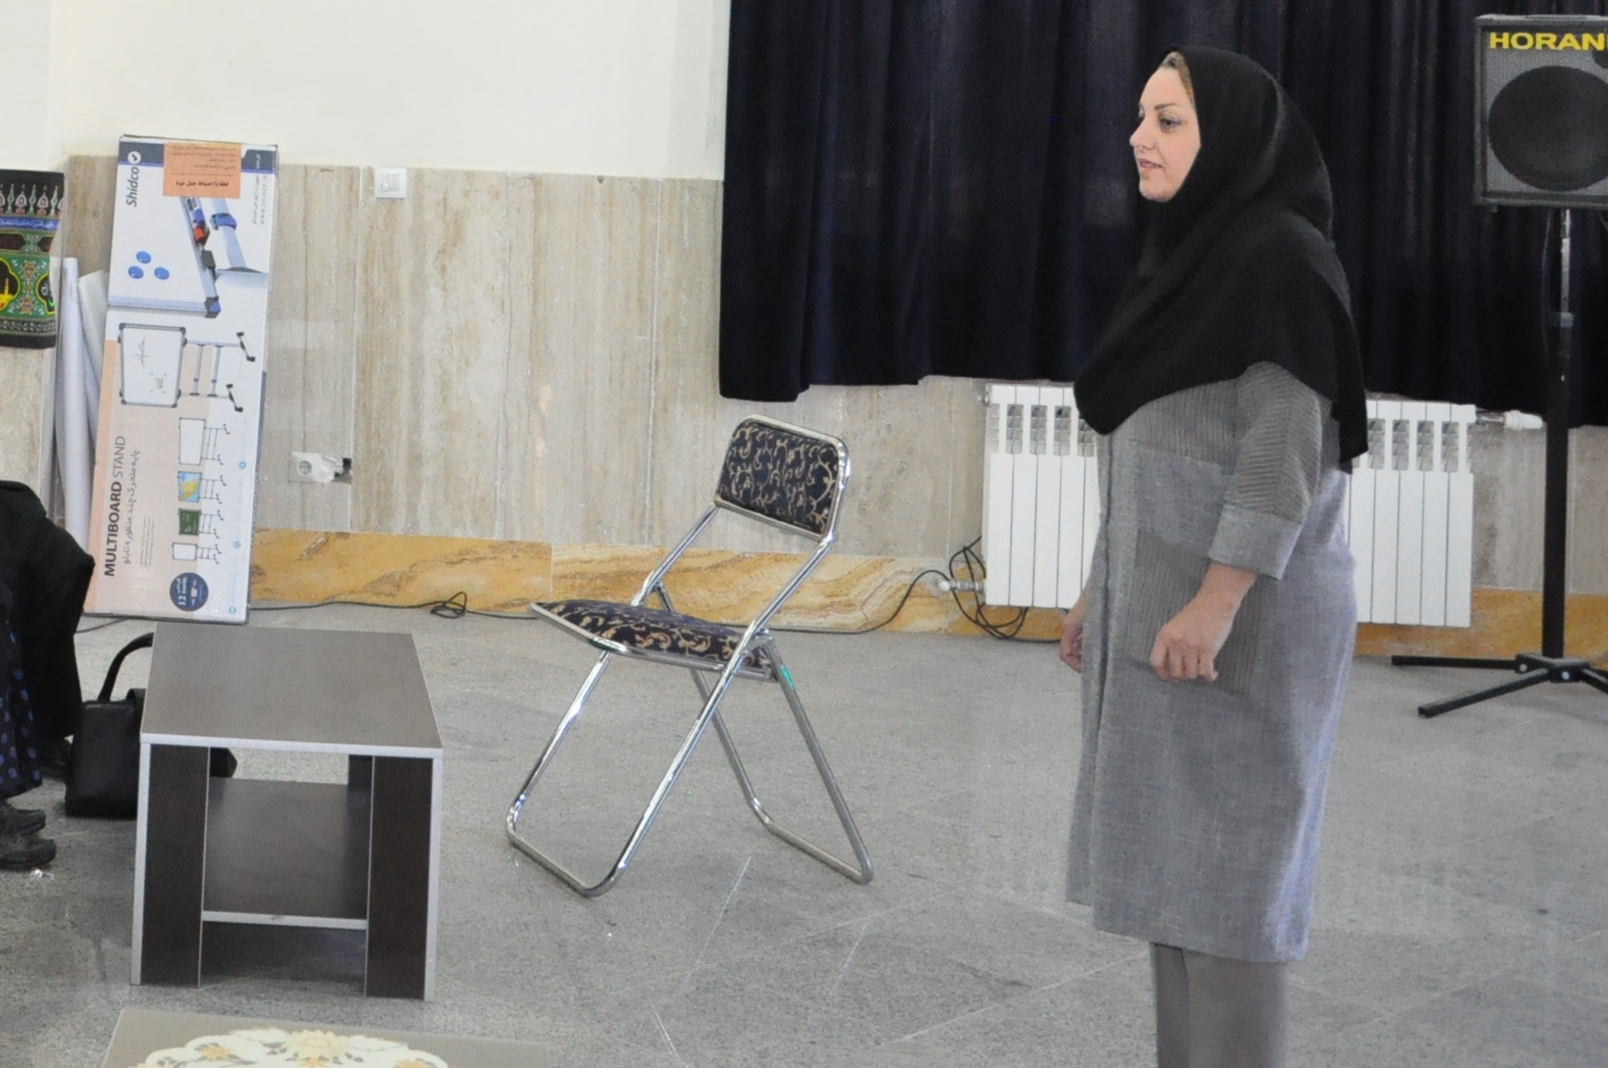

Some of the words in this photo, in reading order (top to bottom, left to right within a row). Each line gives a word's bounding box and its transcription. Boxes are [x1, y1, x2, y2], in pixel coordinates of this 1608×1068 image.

[1489, 31, 1608, 51] HORAN
[125, 166, 140, 207] Shidco
[112, 435, 126, 479] STAND
[130, 450, 141, 467] پایه
[127, 467, 138, 497] متحرک
[104, 481, 123, 577] MULTIBOARD
